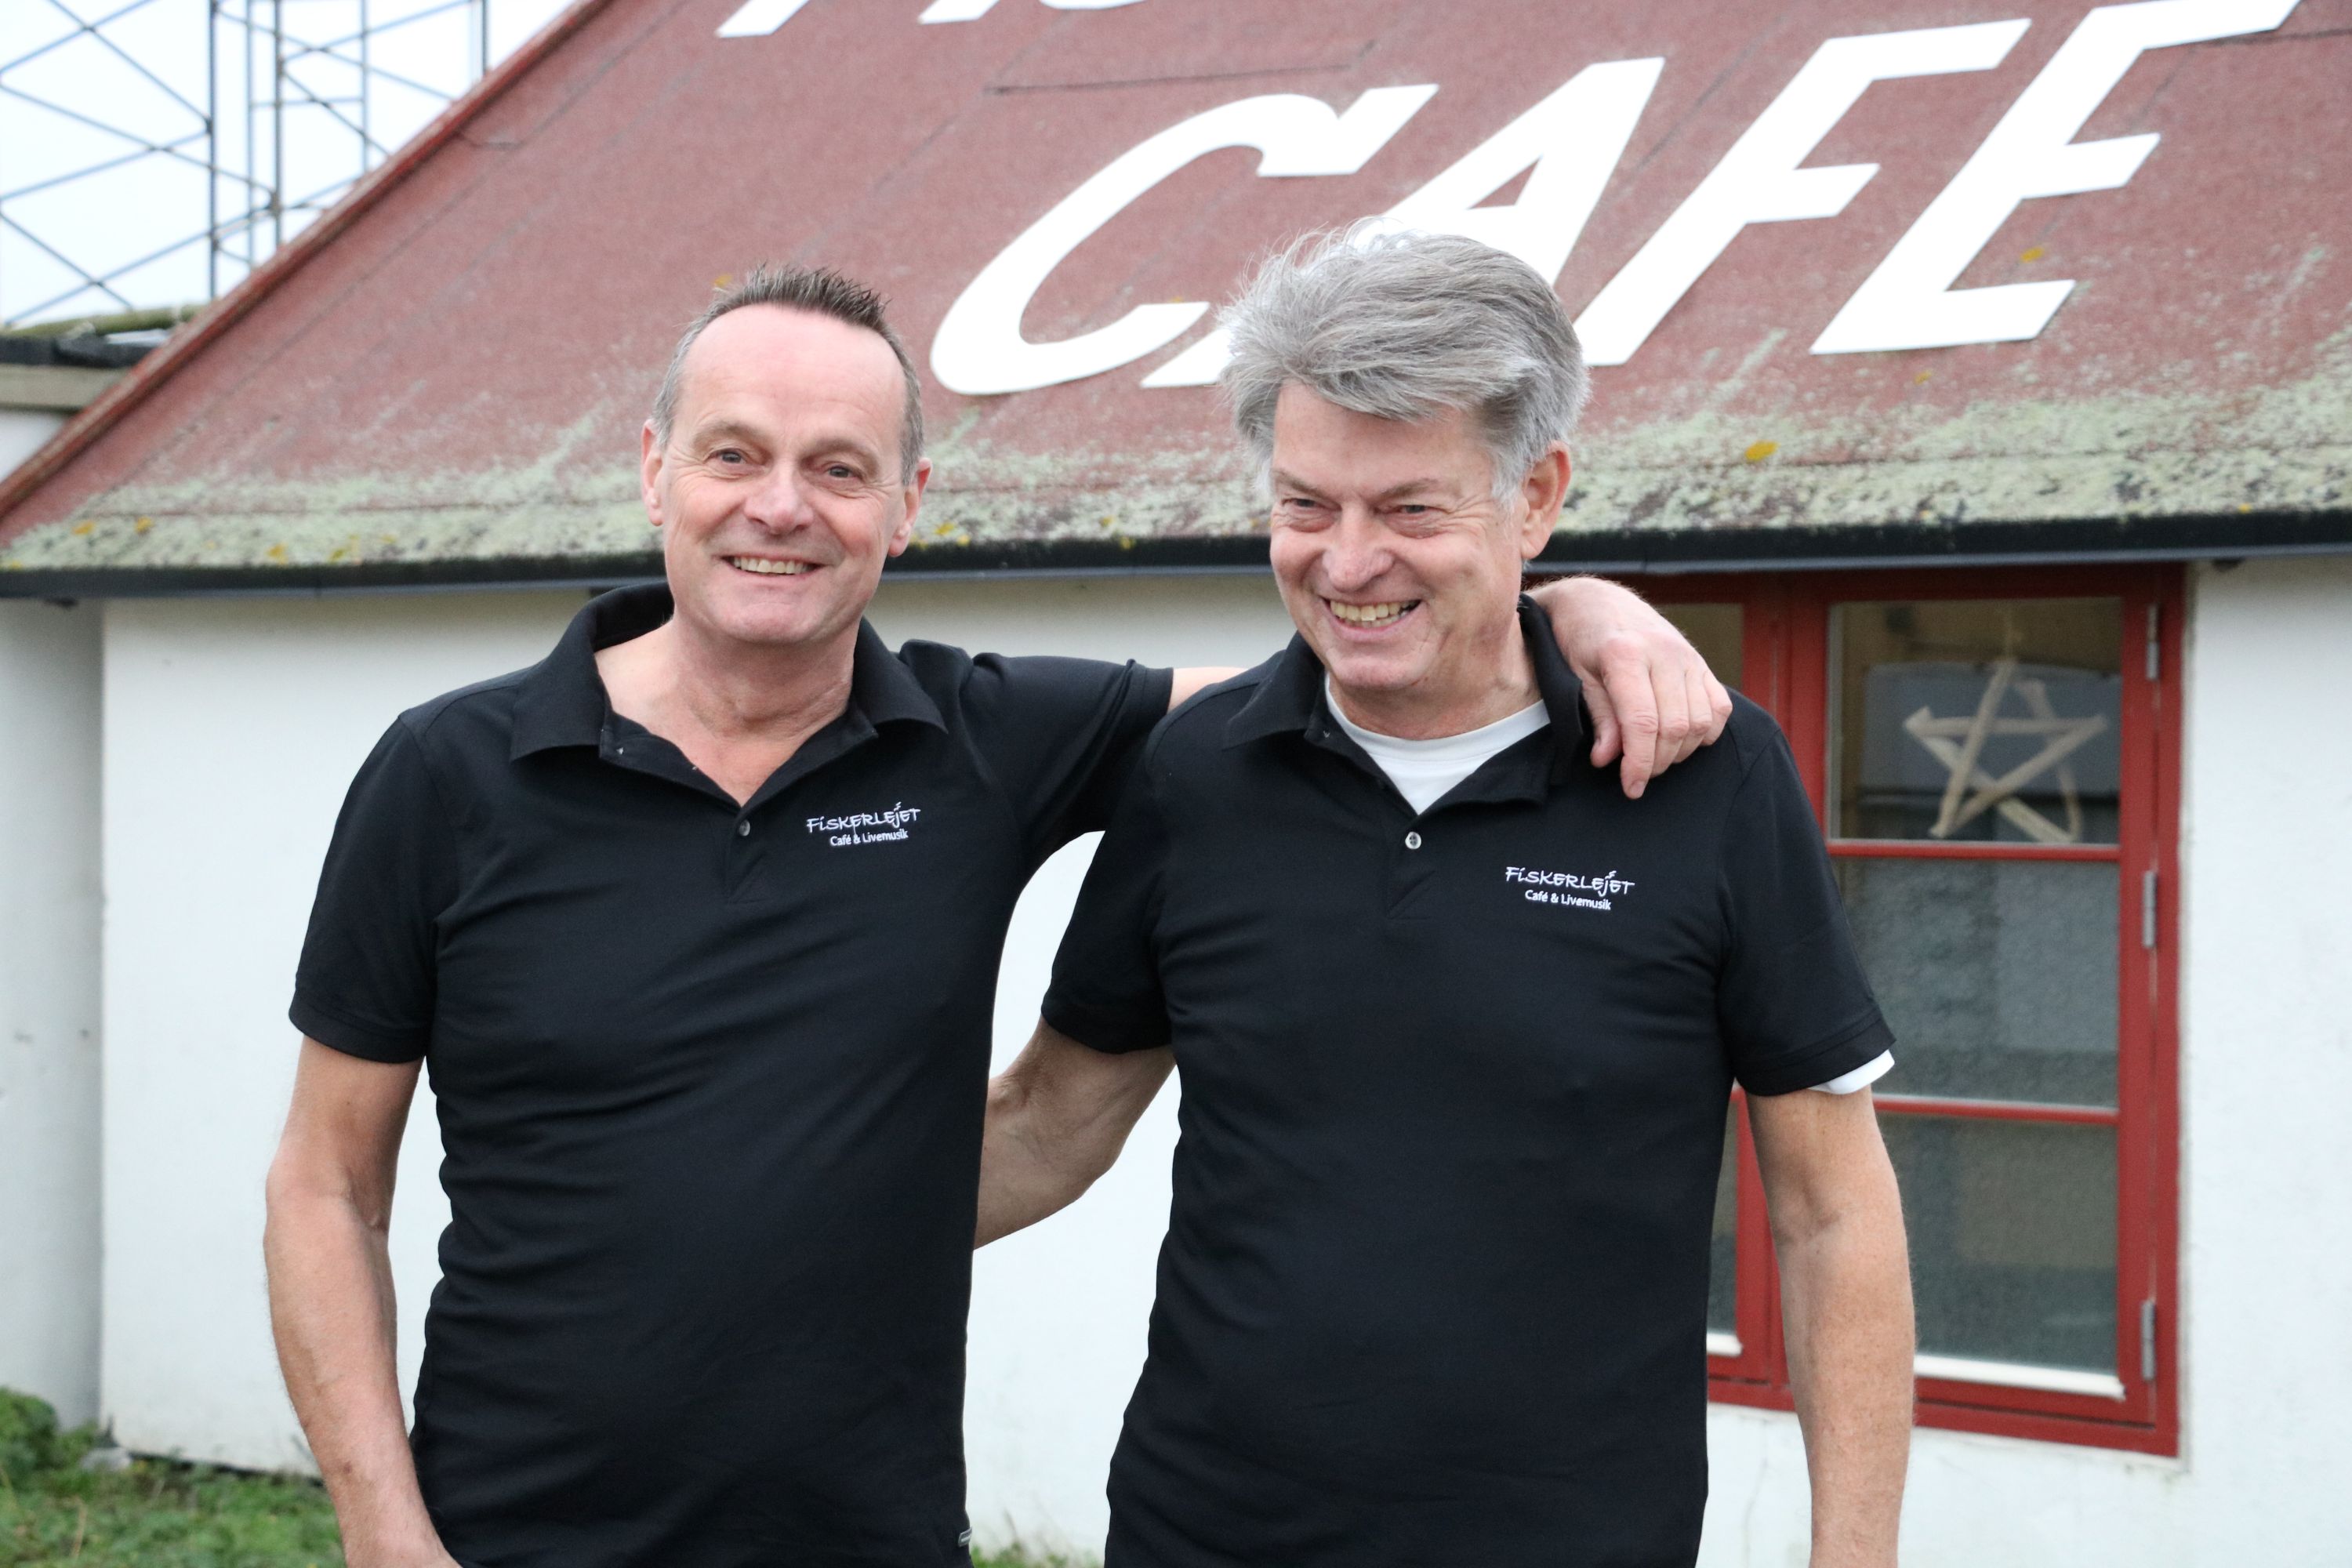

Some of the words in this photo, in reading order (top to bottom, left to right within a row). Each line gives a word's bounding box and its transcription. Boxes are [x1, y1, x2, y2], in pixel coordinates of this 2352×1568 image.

[829, 833, 852, 847] Café
[853, 833, 861, 844] &
[862, 828, 909, 844] Livemusik
[1525, 889, 1549, 902] Café
[1550, 892, 1559, 904] &
[1560, 893, 1612, 910] Livemusik
